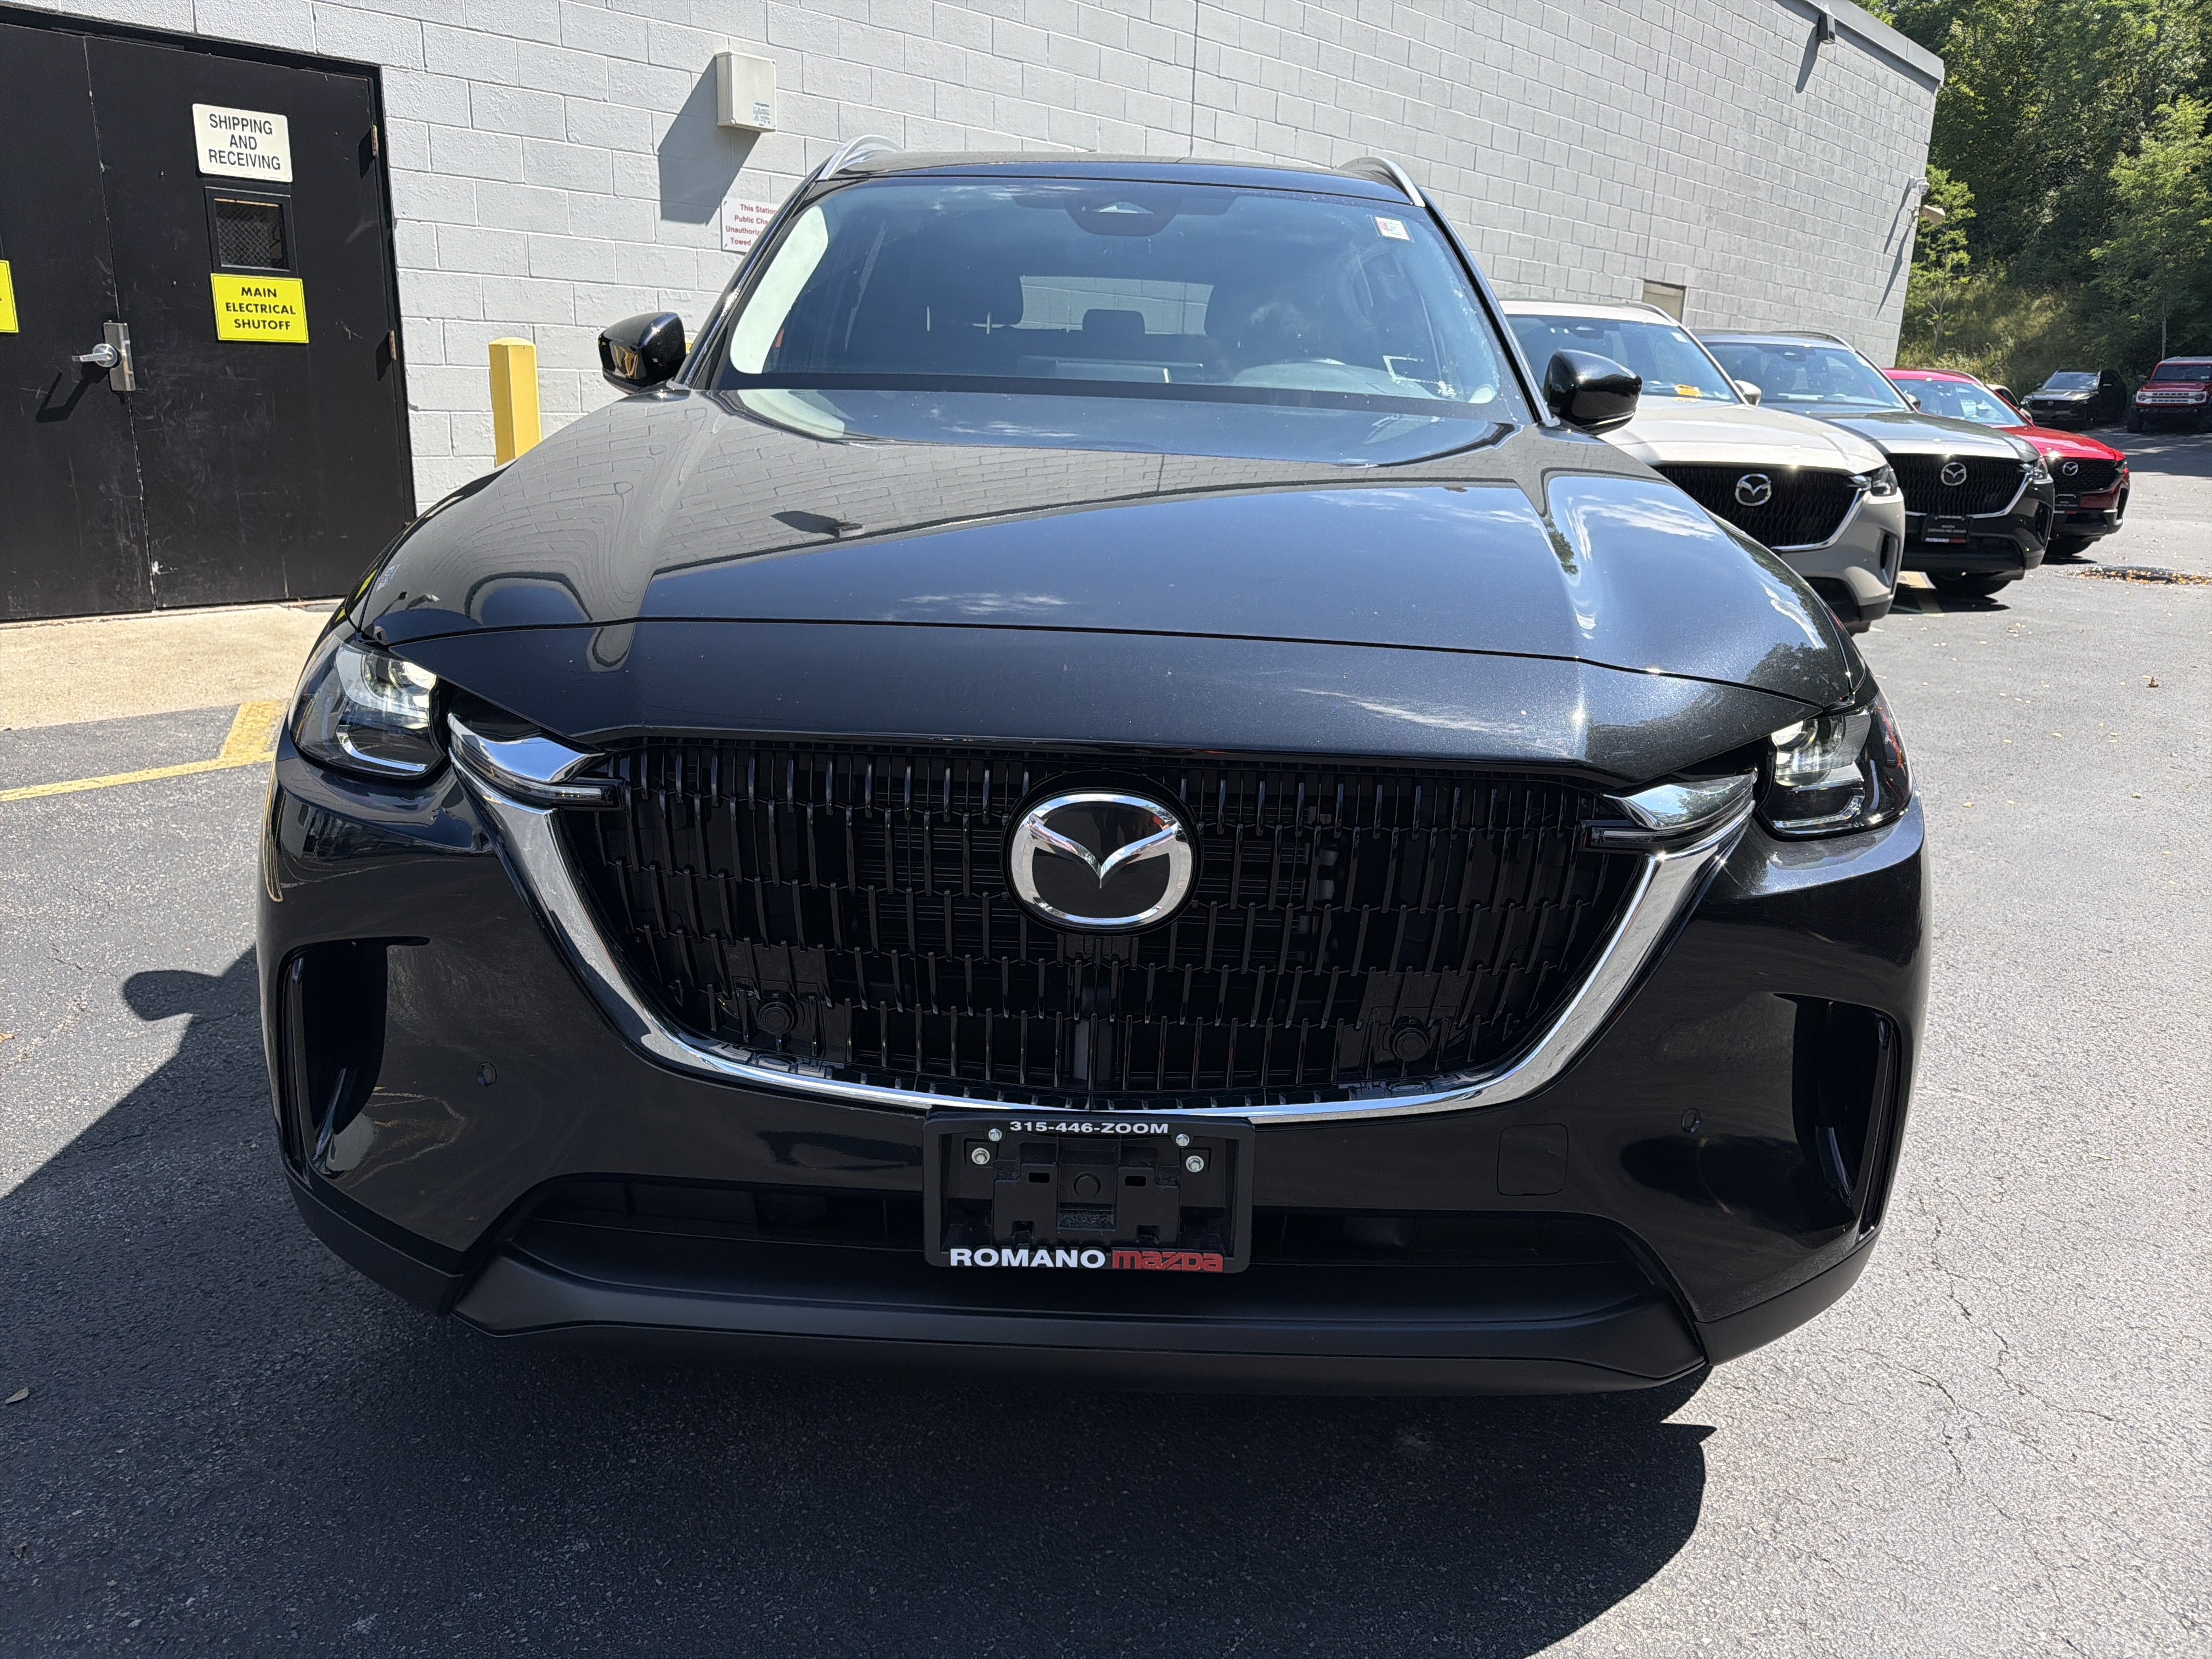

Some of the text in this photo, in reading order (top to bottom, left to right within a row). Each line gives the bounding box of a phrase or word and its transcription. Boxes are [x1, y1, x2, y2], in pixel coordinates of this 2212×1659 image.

[209, 113, 273, 135] SHIPPING
[229, 134, 257, 150] AND
[208, 149, 281, 171] RECEIVING
[740, 204, 754, 212] This
[735, 215, 754, 224] Public
[725, 225, 761, 236] Unauthoriz
[730, 237, 752, 246] Towed
[241, 286, 277, 298] MAIN
[225, 302, 296, 315] ELECTRICAL
[234, 318, 290, 331] SHUTOFF
[1009, 1121, 1169, 1134] 315-446-ZOOM
[950, 1248, 1105, 1268] ROMANO
